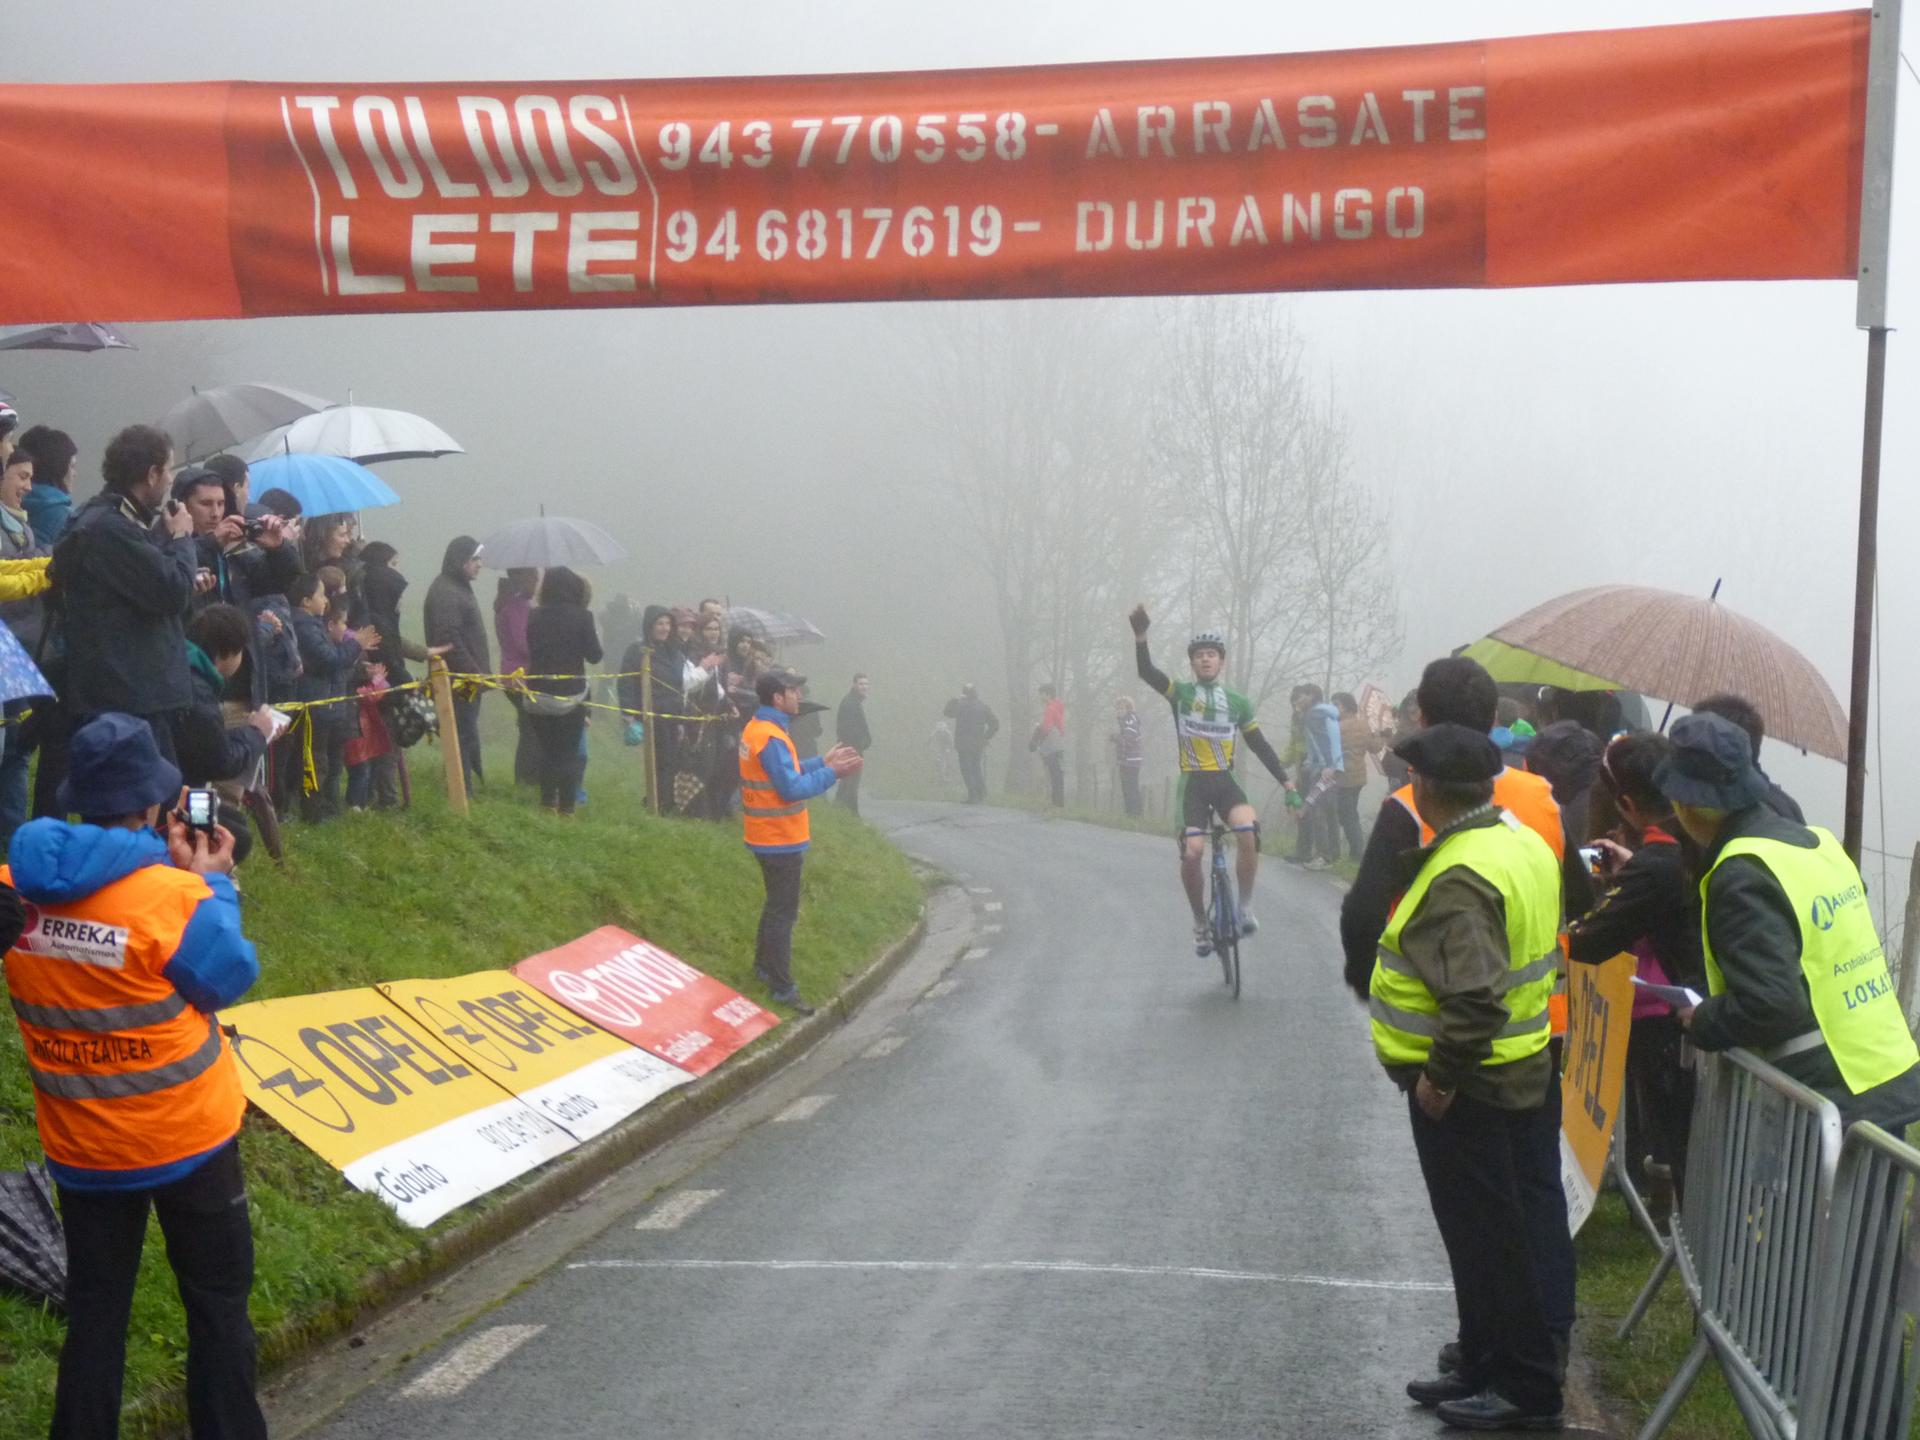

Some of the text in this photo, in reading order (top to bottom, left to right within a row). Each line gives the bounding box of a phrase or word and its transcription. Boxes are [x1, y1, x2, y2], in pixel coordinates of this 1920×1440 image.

[295, 95, 638, 199] TOLDOS
[658, 121, 773, 171] 943
[1086, 86, 1487, 159] ARRASATE
[330, 211, 640, 295] LETE
[665, 207, 740, 262] 94
[1075, 186, 1425, 252] DURANGO
[42, 918, 116, 946] ERREKA
[581, 942, 705, 1008] TOYOTA
[457, 990, 597, 1053] OPEL
[299, 1015, 472, 1105] OPEL
[374, 1160, 449, 1203] Giauto
